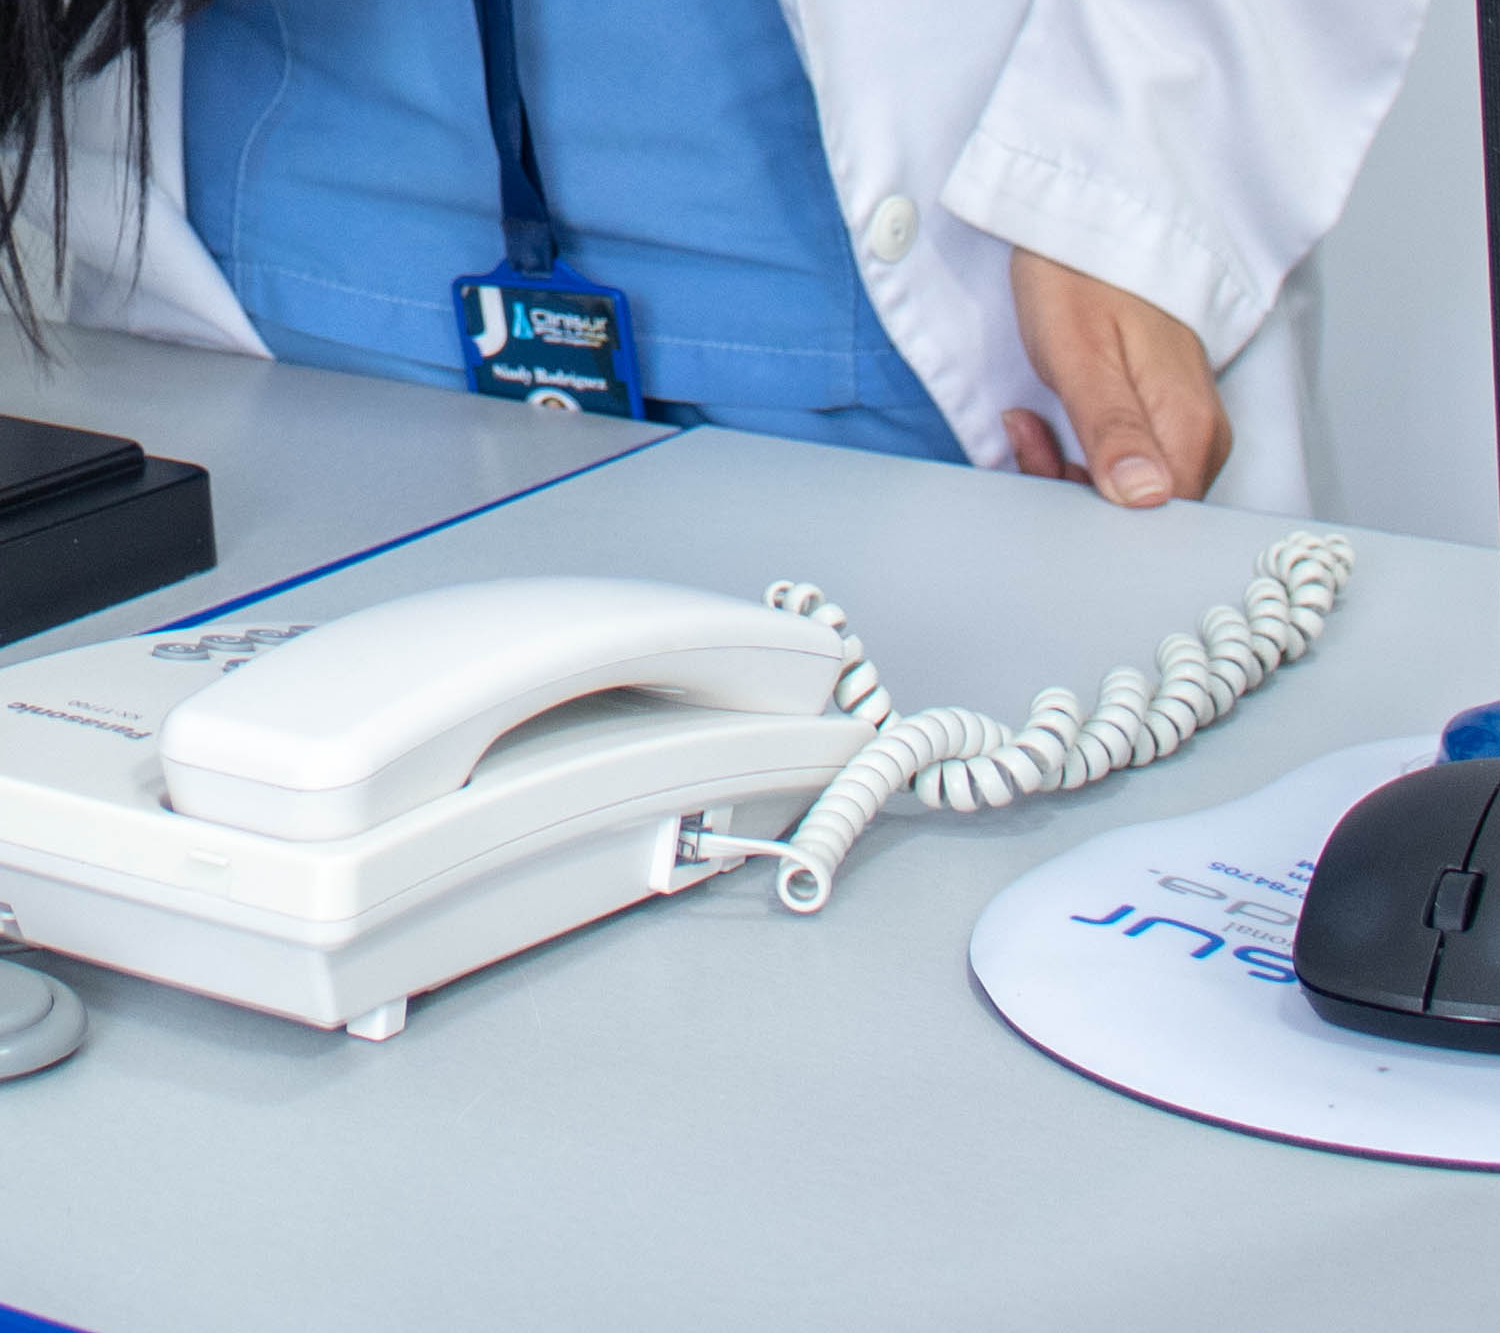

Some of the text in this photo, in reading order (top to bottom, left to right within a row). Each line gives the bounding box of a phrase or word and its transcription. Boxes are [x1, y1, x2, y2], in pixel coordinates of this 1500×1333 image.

[7, 701, 152, 740] Panasonic
[1208, 861, 1305, 899] 784705
[1070, 904, 1297, 983] sur
[1222, 922, 1294, 947] ional
